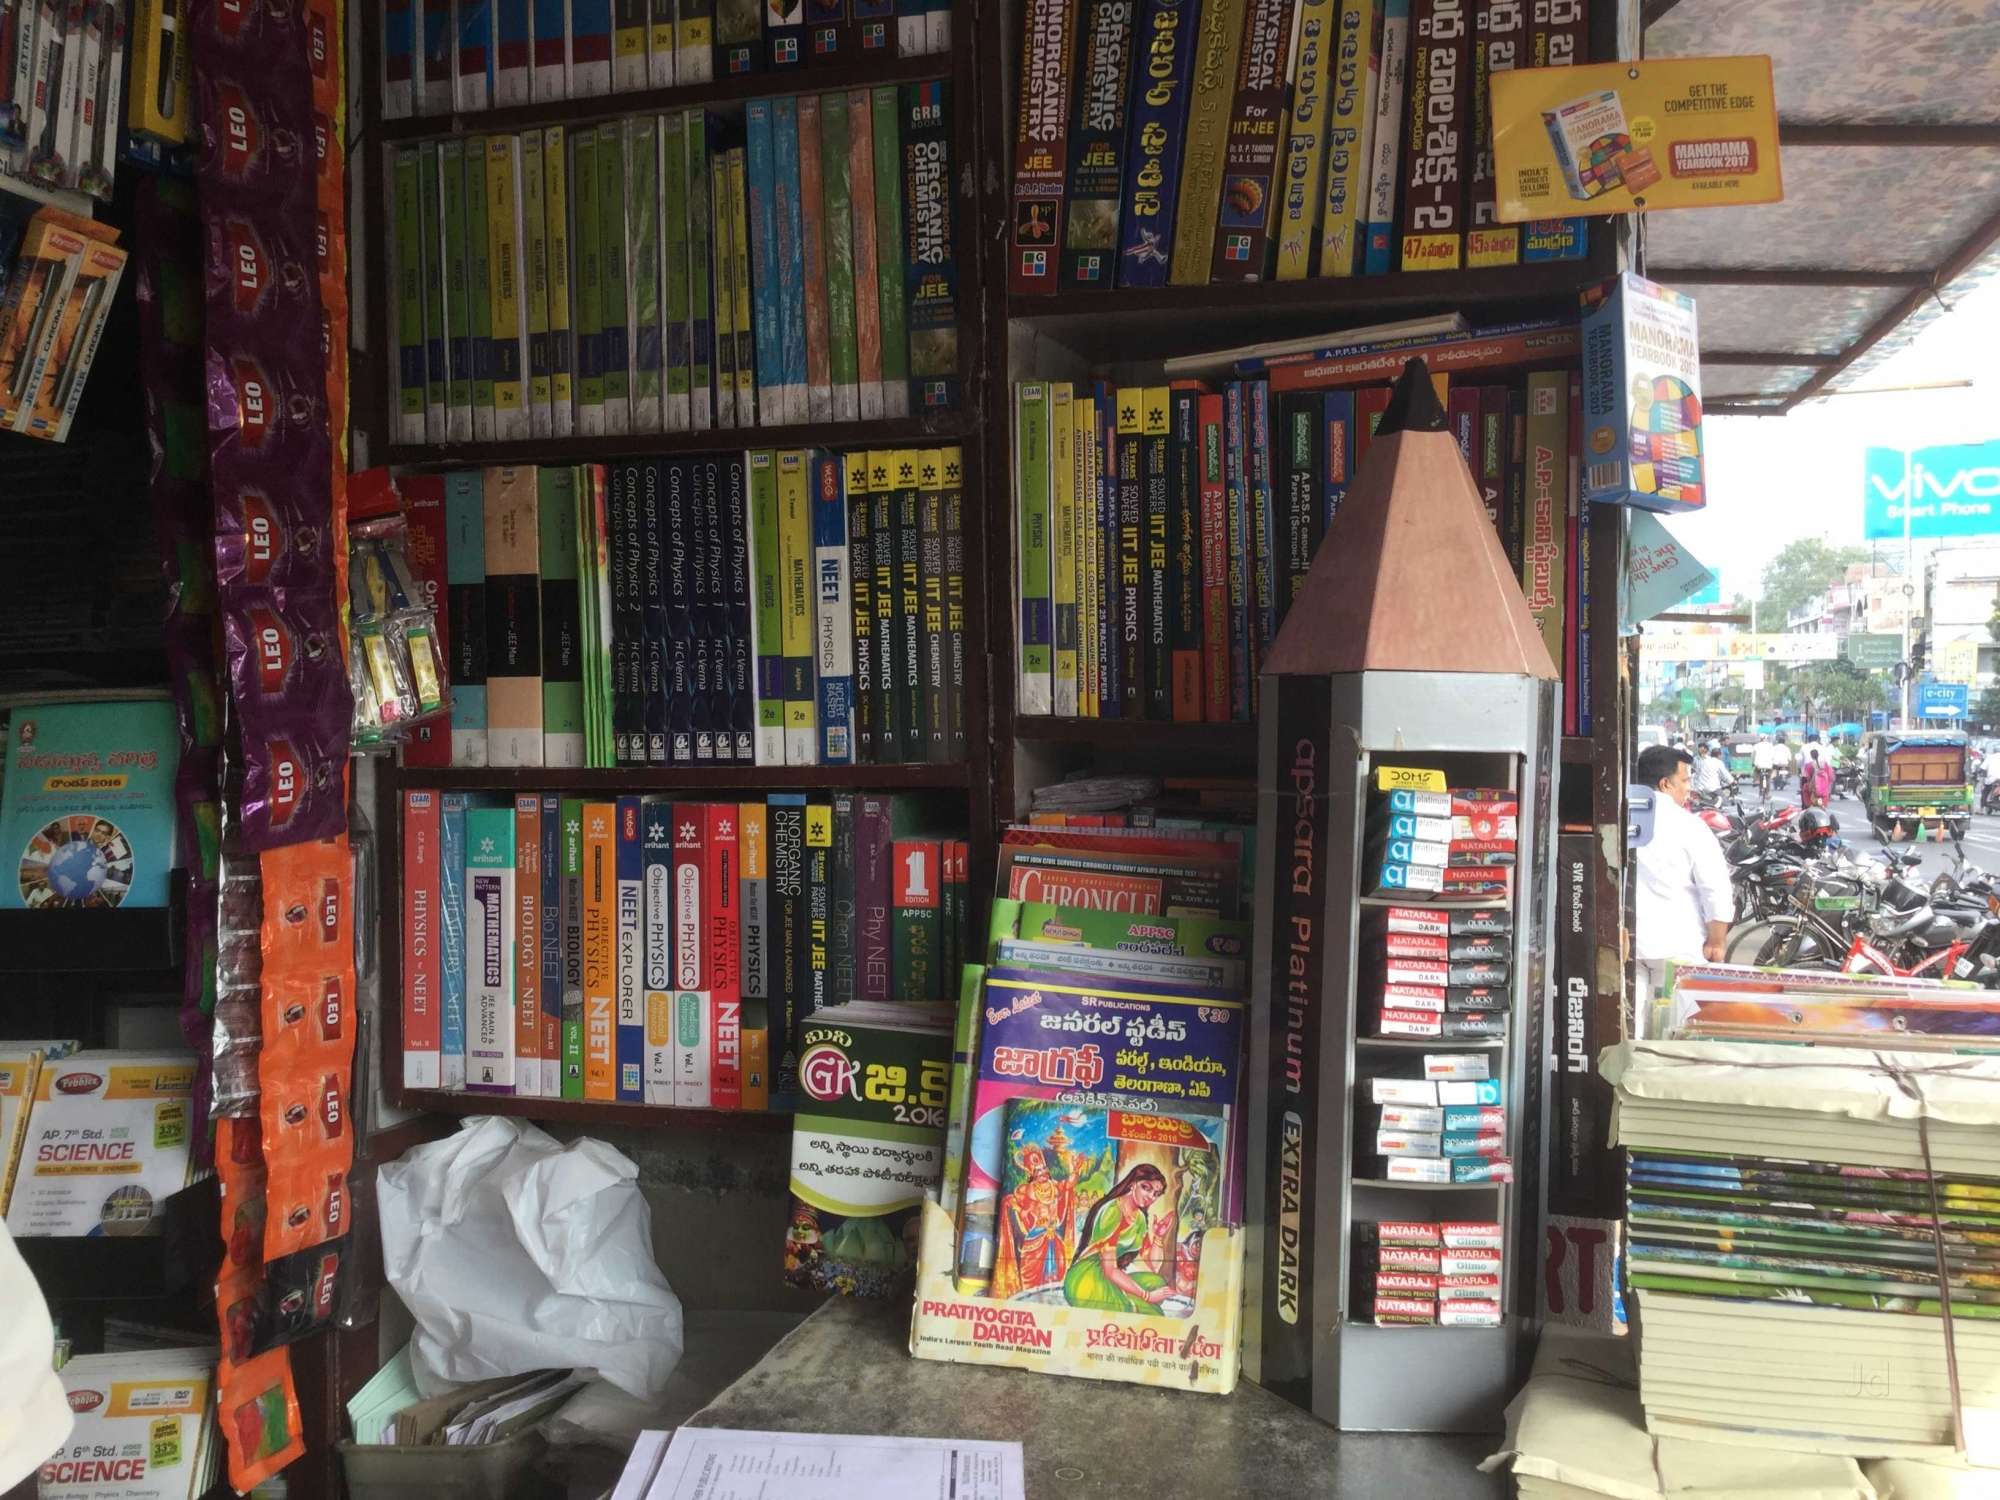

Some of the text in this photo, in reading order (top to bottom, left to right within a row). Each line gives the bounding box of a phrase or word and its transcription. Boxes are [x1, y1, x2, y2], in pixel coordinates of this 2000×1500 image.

[1089, 3, 1111, 131] CHEMISTRY
[1102, 3, 1125, 132] ORGANIC
[1664, 97, 1755, 112] COMPETITIVE EDGE
[1689, 84, 1729, 98] GET THE
[912, 107, 941, 121] GRB
[1246, 106, 1267, 118] For
[1024, 155, 1053, 169] JEE
[1081, 151, 1116, 166] JEE
[1675, 141, 1749, 159] MANORAMA
[1677, 157, 1749, 170] YEARBOOK 2017
[913, 143, 932, 265] CHEMISTRY
[927, 142, 944, 265] ORGANIC
[917, 282, 949, 299] JEE
[1629, 321, 1696, 357] MANORAMA
[1600, 323, 1615, 416] MANORAMA
[244, 381, 264, 425] LEO
[1300, 472, 1311, 524] A.P.P.S.C
[1941, 501, 1992, 516] Phone
[252, 517, 270, 560] LEO
[626, 467, 640, 597] Concepts of Physics
[646, 466, 659, 596] Concepts Physics
[669, 466, 685, 596] Concepts of Physics
[706, 463, 722, 594] Concepts of Physics
[730, 463, 745, 593] Concepts of Physics
[1122, 526, 1138, 551] IIT
[853, 544, 862, 579] PAPERS
[860, 545, 869, 579] SOLVED
[875, 533, 884, 566] PAPERS
[883, 532, 891, 566] SOLVED
[908, 529, 917, 562] SOLVED
[793, 559, 805, 616] MATHEMATICS
[821, 560, 839, 602] NEET
[1150, 514, 1165, 645] IIT MATHEMATICS
[854, 582, 870, 637] IIT JEE
[903, 563, 918, 687] IIT JEE MATHEMATICS
[823, 616, 833, 669] PHYSICS
[877, 566, 892, 689] IIT JEE MATHEMATICS
[925, 577, 942, 688] IIT CHEMISTRY
[262, 628, 282, 671] LEO
[953, 632, 963, 686] CHEMISTRY
[1029, 655, 1041, 664] 2e
[631, 658, 641, 692] Verma
[675, 657, 685, 692] Verma
[736, 656, 746, 690] Verma
[827, 683, 836, 718] BASED
[1926, 688, 1956, 700] e-city
[765, 708, 775, 719] 2e
[794, 711, 805, 721] 2e
[278, 761, 294, 804] LEO
[1391, 770, 1432, 782] DOMS
[411, 793, 431, 804] EXAM
[518, 799, 536, 808] EXAM
[1416, 794, 1449, 806] platinum
[472, 855, 502, 864] arihant
[569, 836, 577, 871] arihant
[644, 841, 669, 849] arihant
[675, 841, 701, 849] arihant
[775, 810, 788, 897] CHEMISTRY
[788, 811, 801, 896] INORGANIC
[1460, 840, 1503, 850] NATARAJ
[905, 851, 930, 897] 1
[943, 858, 952, 875] 1
[955, 857, 964, 872] 1
[1408, 866, 1441, 878] platinum
[1452, 870, 1495, 879] NATARAJ
[1572, 861, 1583, 882] SVR
[905, 896, 930, 904] EDITION
[1020, 870, 1157, 916] CHRONICLE
[326, 895, 337, 926] LEO
[652, 867, 664, 986] Objective PHYSICS
[682, 867, 695, 986] Objective PHYSICS
[863, 906, 885, 942] Phy
[902, 909, 932, 919] APPSC
[1285, 737, 1316, 1094] apsara Platinum
[1395, 910, 1439, 921] NATARAJ
[1467, 918, 1496, 928] QUICKY
[487, 892, 500, 986] MATHEMATICS
[1129, 924, 1176, 941] APPSC
[1418, 924, 1440, 932] DARK
[414, 889, 427, 1016] PHYSICS NEET
[522, 895, 535, 1030] BIOLOGY NEET
[567, 926, 580, 987] BIOLOGY
[621, 886, 637, 1019] NEET EXPLORER
[713, 917, 727, 990] PHYSICS
[748, 925, 761, 995] PHYSICS
[1416, 949, 1439, 957] DARK
[1466, 944, 1495, 954] QUICKY
[1418, 973, 1440, 981] DARK
[1466, 970, 1495, 980] QUICKY
[327, 992, 339, 1025] LEO
[1082, 996, 1151, 1012] SR PUBLICATIONS
[1465, 995, 1494, 1005] QUICKY
[480, 995, 488, 1044] ADVANCED
[590, 997, 610, 1065] NEET
[1040, 1012, 1187, 1047] జనరల్ స్టడీస్
[1567, 976, 1589, 1073] రీజనింగ్
[718, 1001, 740, 1072] NEET
[804, 1029, 853, 1048] మిని
[654, 1052, 662, 1068] Vol.
[684, 1053, 693, 1068] Vol.
[993, 1043, 1105, 1089] జాగ్రఫీ
[806, 1057, 863, 1102] GK
[326, 1090, 339, 1123] LEO
[892, 1104, 944, 1127] 2016
[82, 1129, 104, 1140] Std.
[810, 1139, 869, 1159] అన్ని స్థాయి
[37, 1142, 135, 1163] SCIENCE
[799, 1161, 823, 1176] అన్ని
[1279, 1119, 1300, 1315] EXTRA DARK
[1381, 1225, 1433, 1237] NATARAJ
[1381, 1250, 1434, 1262] NATARAJ
[1377, 1276, 1431, 1287] NATARAJ
[922, 1301, 1037, 1327] PRATIYOGITA
[1377, 1301, 1430, 1312] NATARAJ
[973, 1322, 1053, 1348] DARPAN
[1015, 1345, 1052, 1356] Magazine
[1086, 1323, 1175, 1354] प्रतियोगिता
[93, 1446, 118, 1457] Std.
[40, 1459, 147, 1484] SCIENCE
